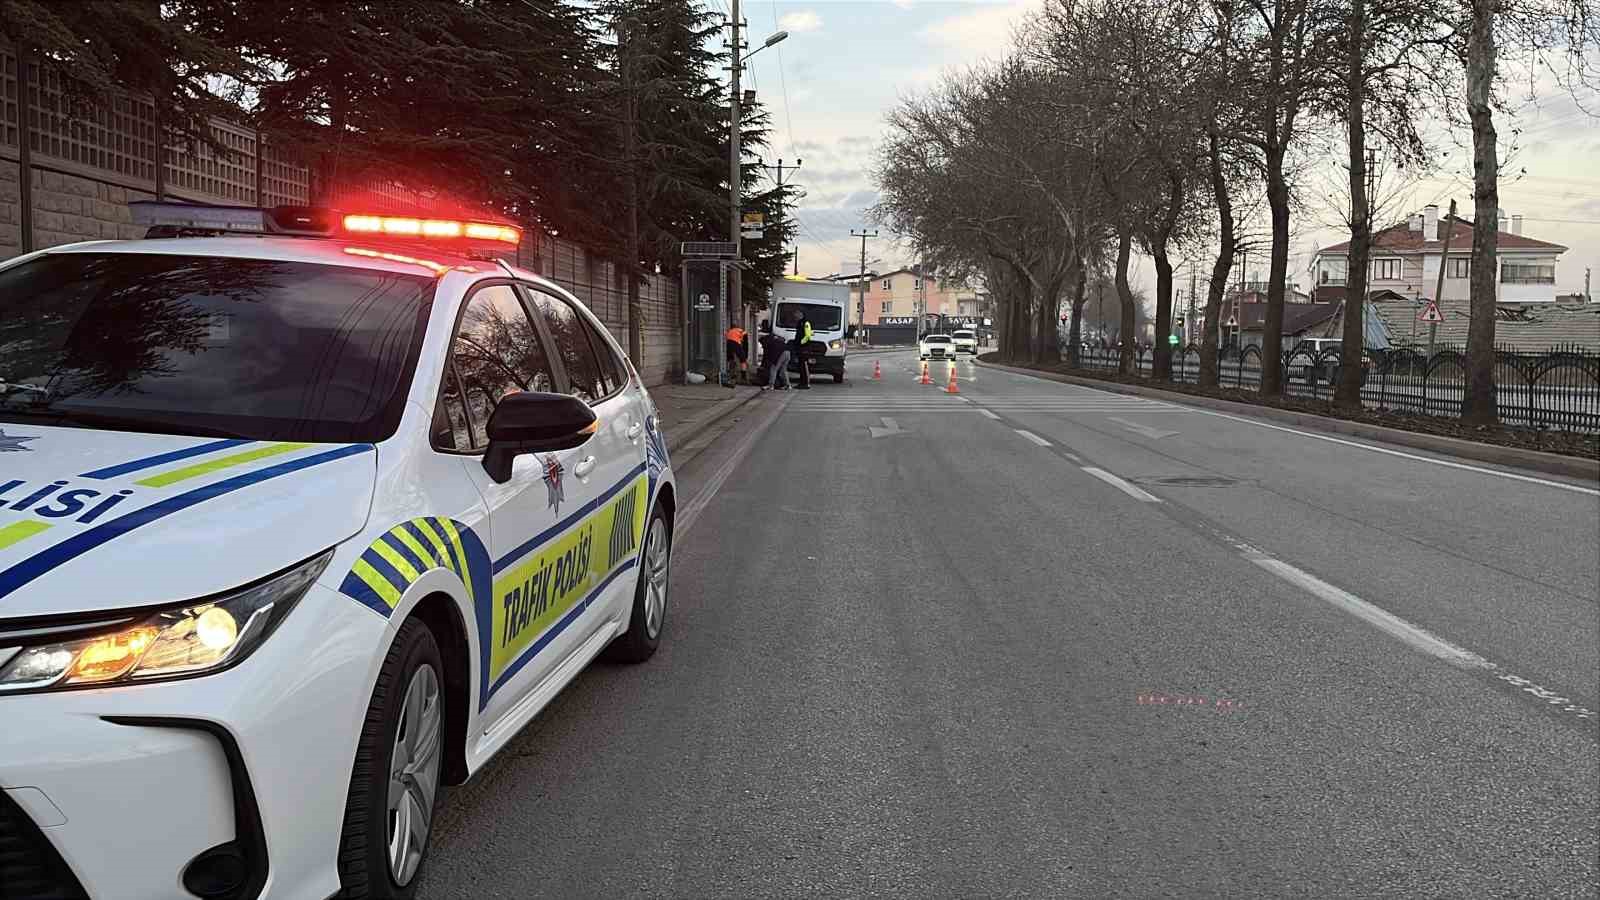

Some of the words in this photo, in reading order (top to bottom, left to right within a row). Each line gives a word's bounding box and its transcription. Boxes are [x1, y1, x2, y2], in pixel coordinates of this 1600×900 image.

[886, 317, 914, 325] KASAP
[502, 558, 553, 648] TRAFİK
[551, 524, 593, 607] POLİSİ
